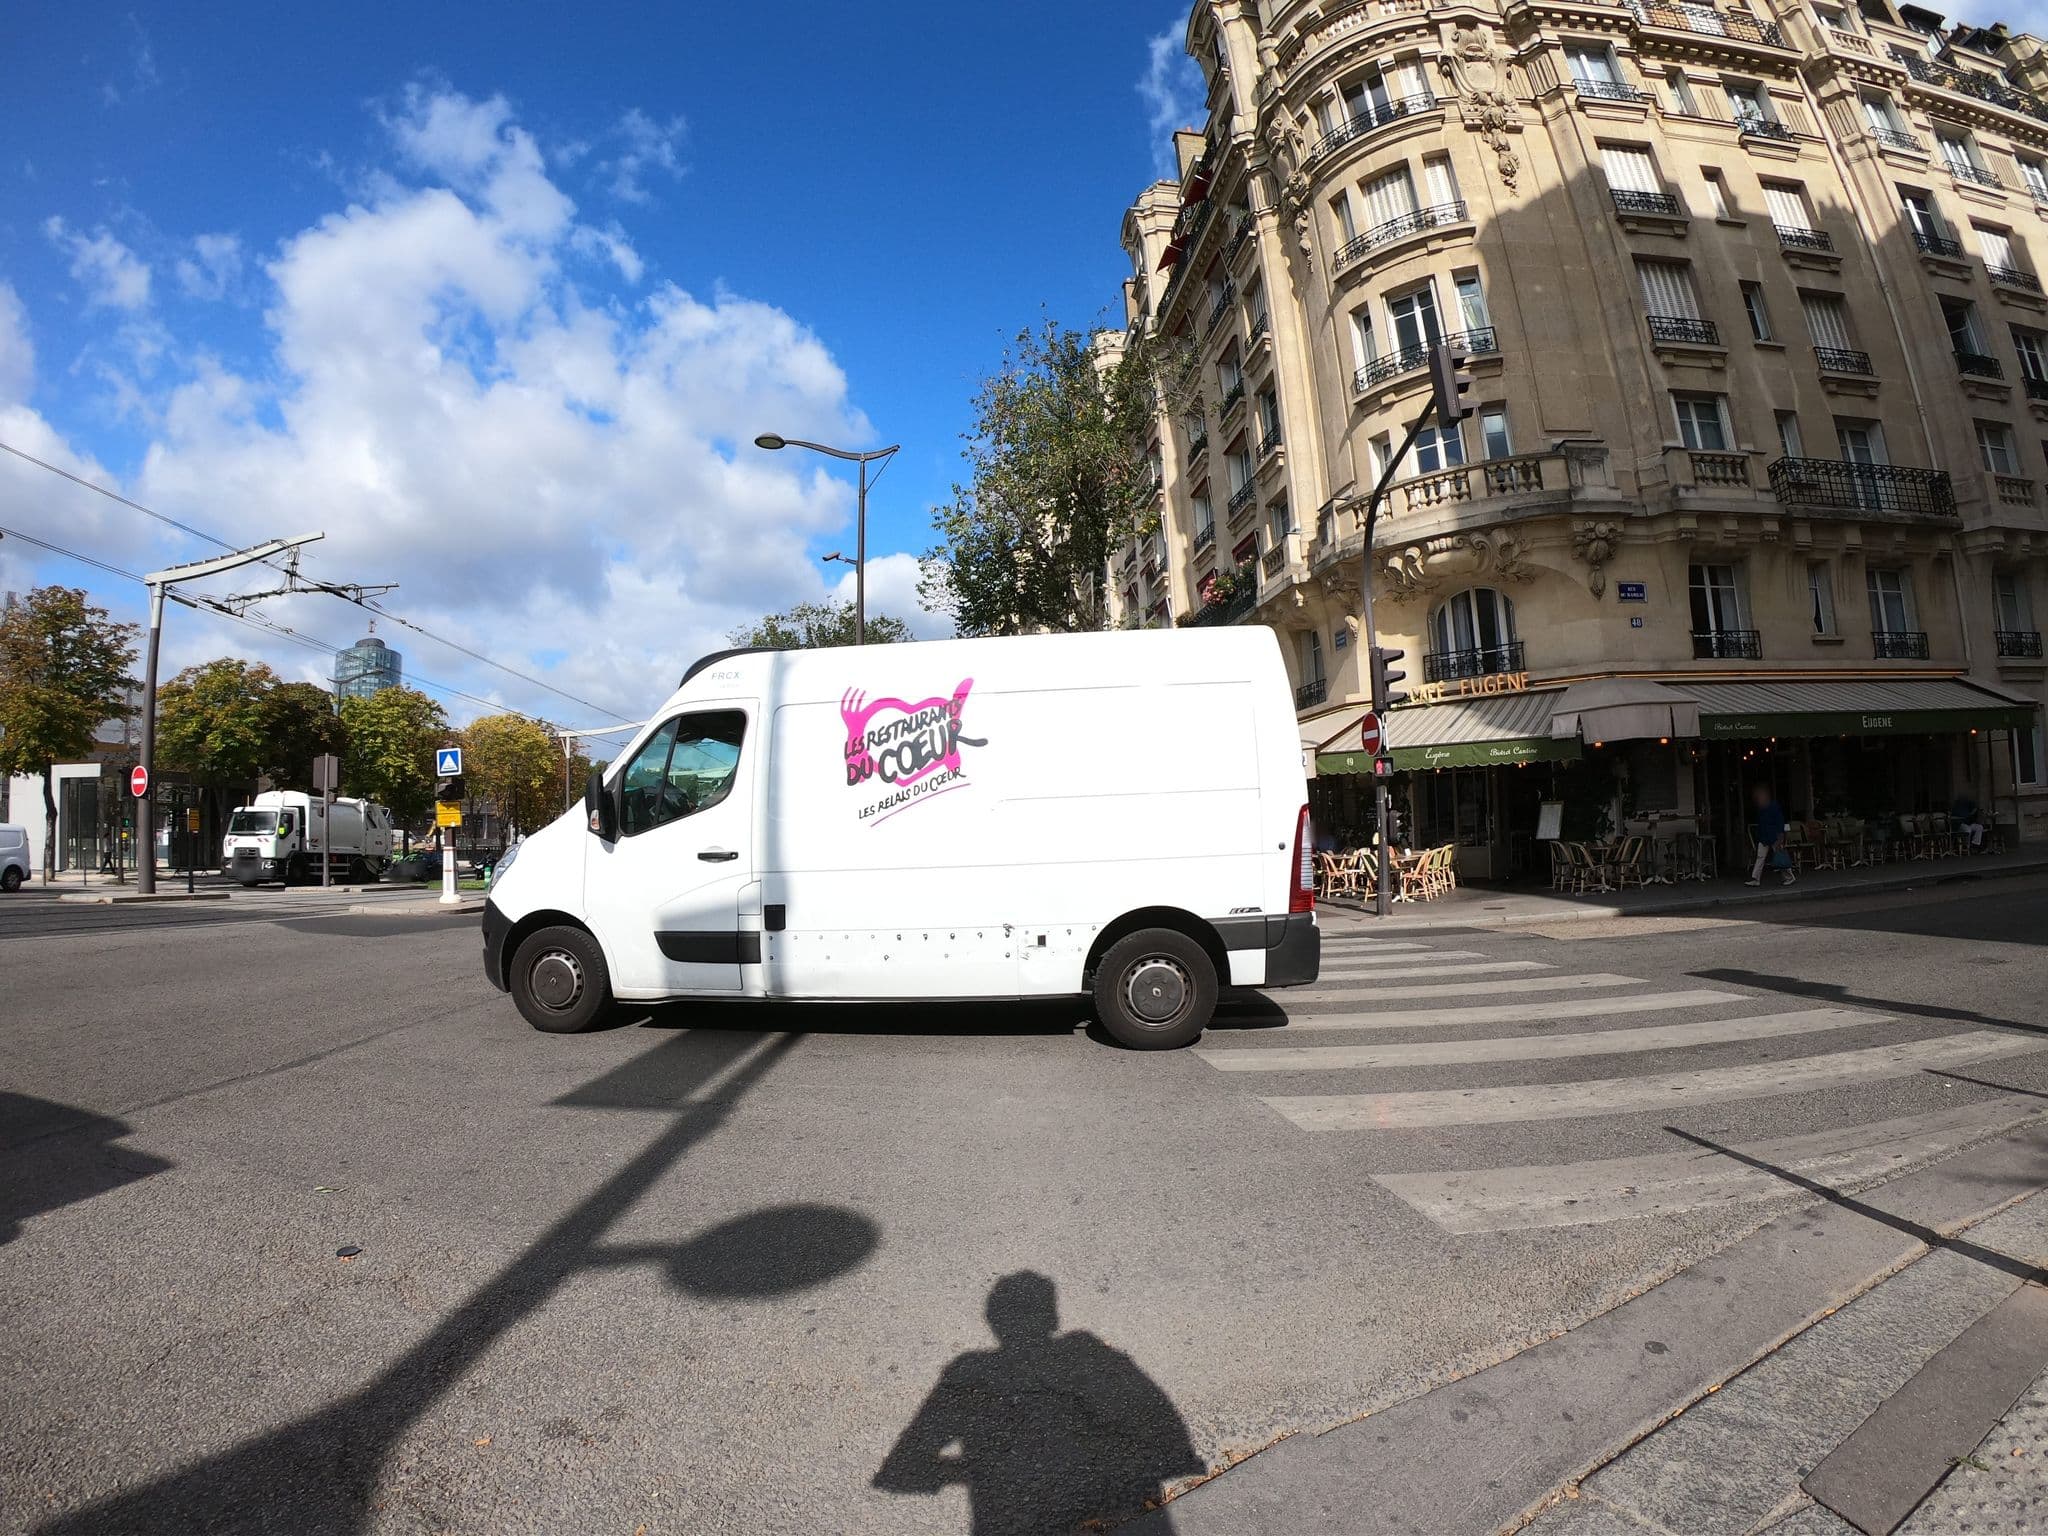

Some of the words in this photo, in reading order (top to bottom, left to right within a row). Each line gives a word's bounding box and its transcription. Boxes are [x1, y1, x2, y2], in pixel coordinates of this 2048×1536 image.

[844, 736, 865, 760] LES
[867, 699, 962, 750] RESTAURANTS
[846, 755, 874, 786] DU
[858, 805, 876, 820] LES
[878, 788, 911, 813] RELAIS
[913, 782, 928, 796] DU
